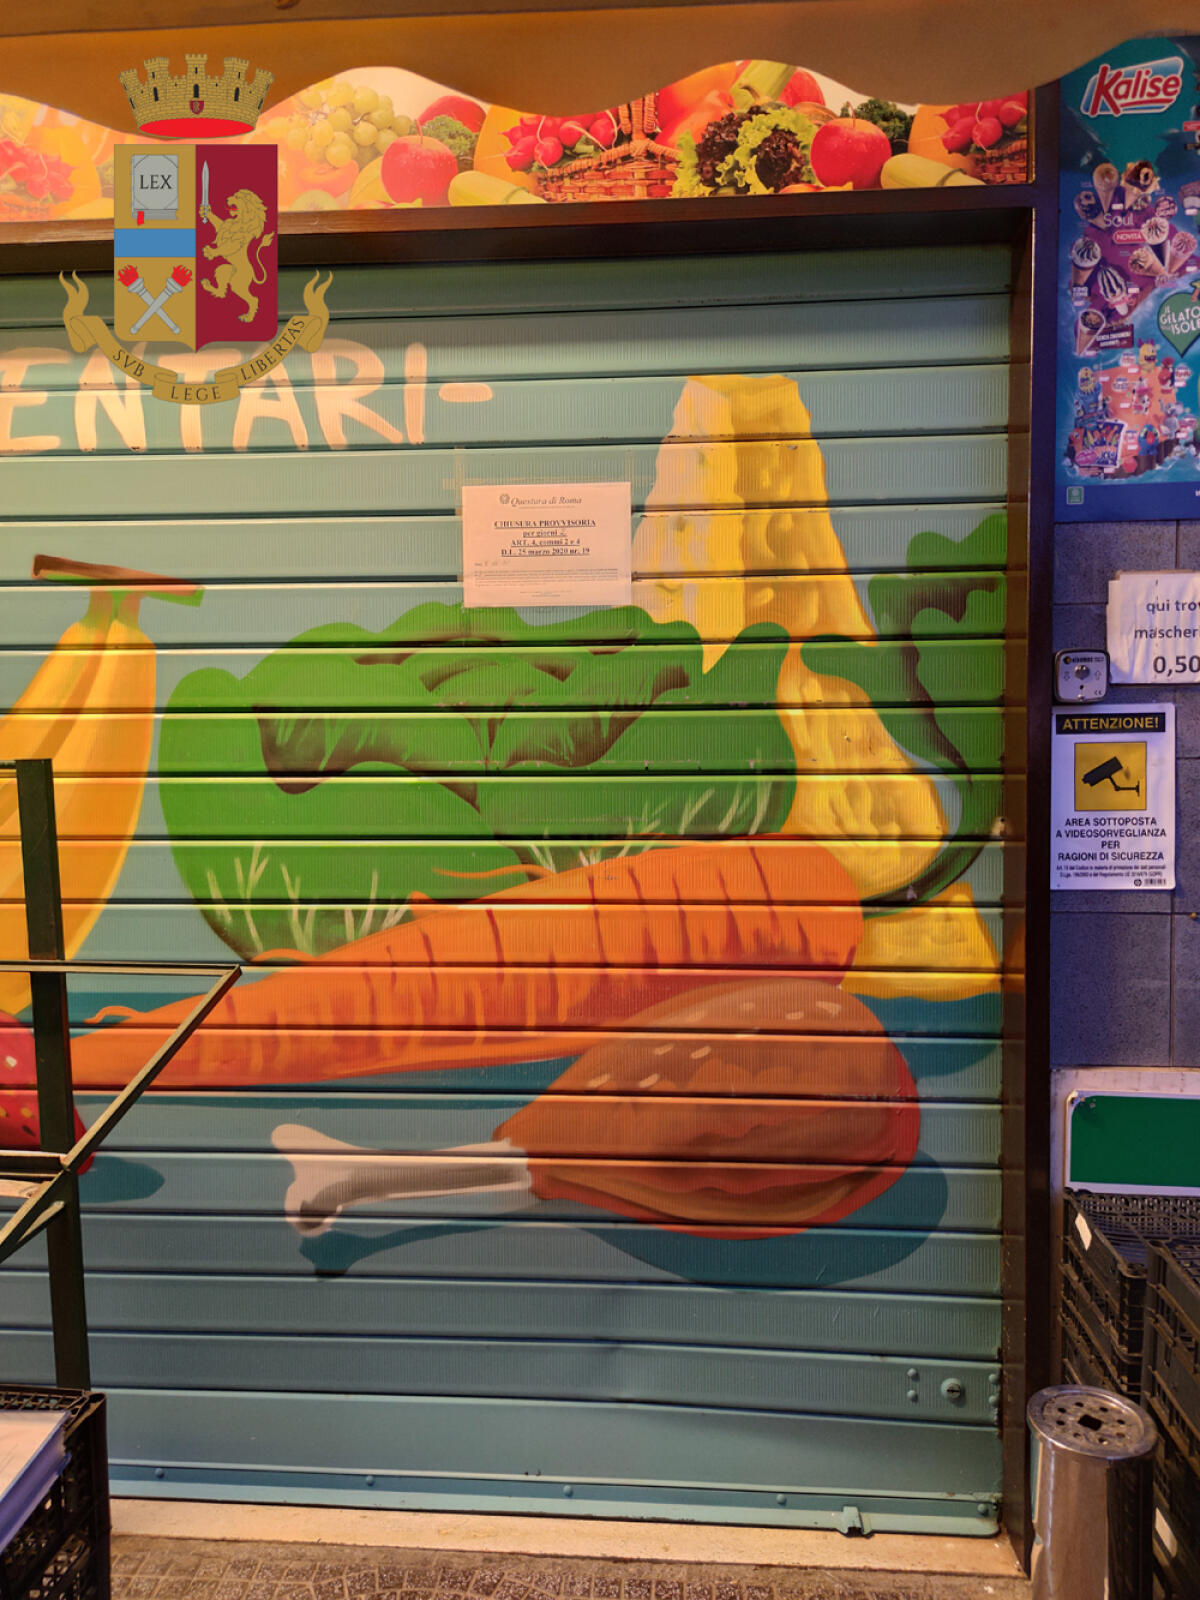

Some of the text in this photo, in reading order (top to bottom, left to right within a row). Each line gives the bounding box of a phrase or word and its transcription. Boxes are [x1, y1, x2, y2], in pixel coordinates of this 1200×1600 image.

[1088, 64, 1181, 116] Kalise
[539, 519, 596, 528] PROVVISORIA
[1146, 599, 1200, 614] qui tro
[1134, 625, 1200, 639] mascher
[1153, 655, 1200, 678] 0,50
[1062, 717, 1159, 730] ATTENZIONE!
[1065, 816, 1157, 827] AREA SOTTOPOSTA
[1056, 828, 1167, 839] A VIDEOSORVEGLIANZA
[1101, 840, 1121, 849] PER
[1058, 851, 1165, 861] RAGIONI DI SICUREZZA
